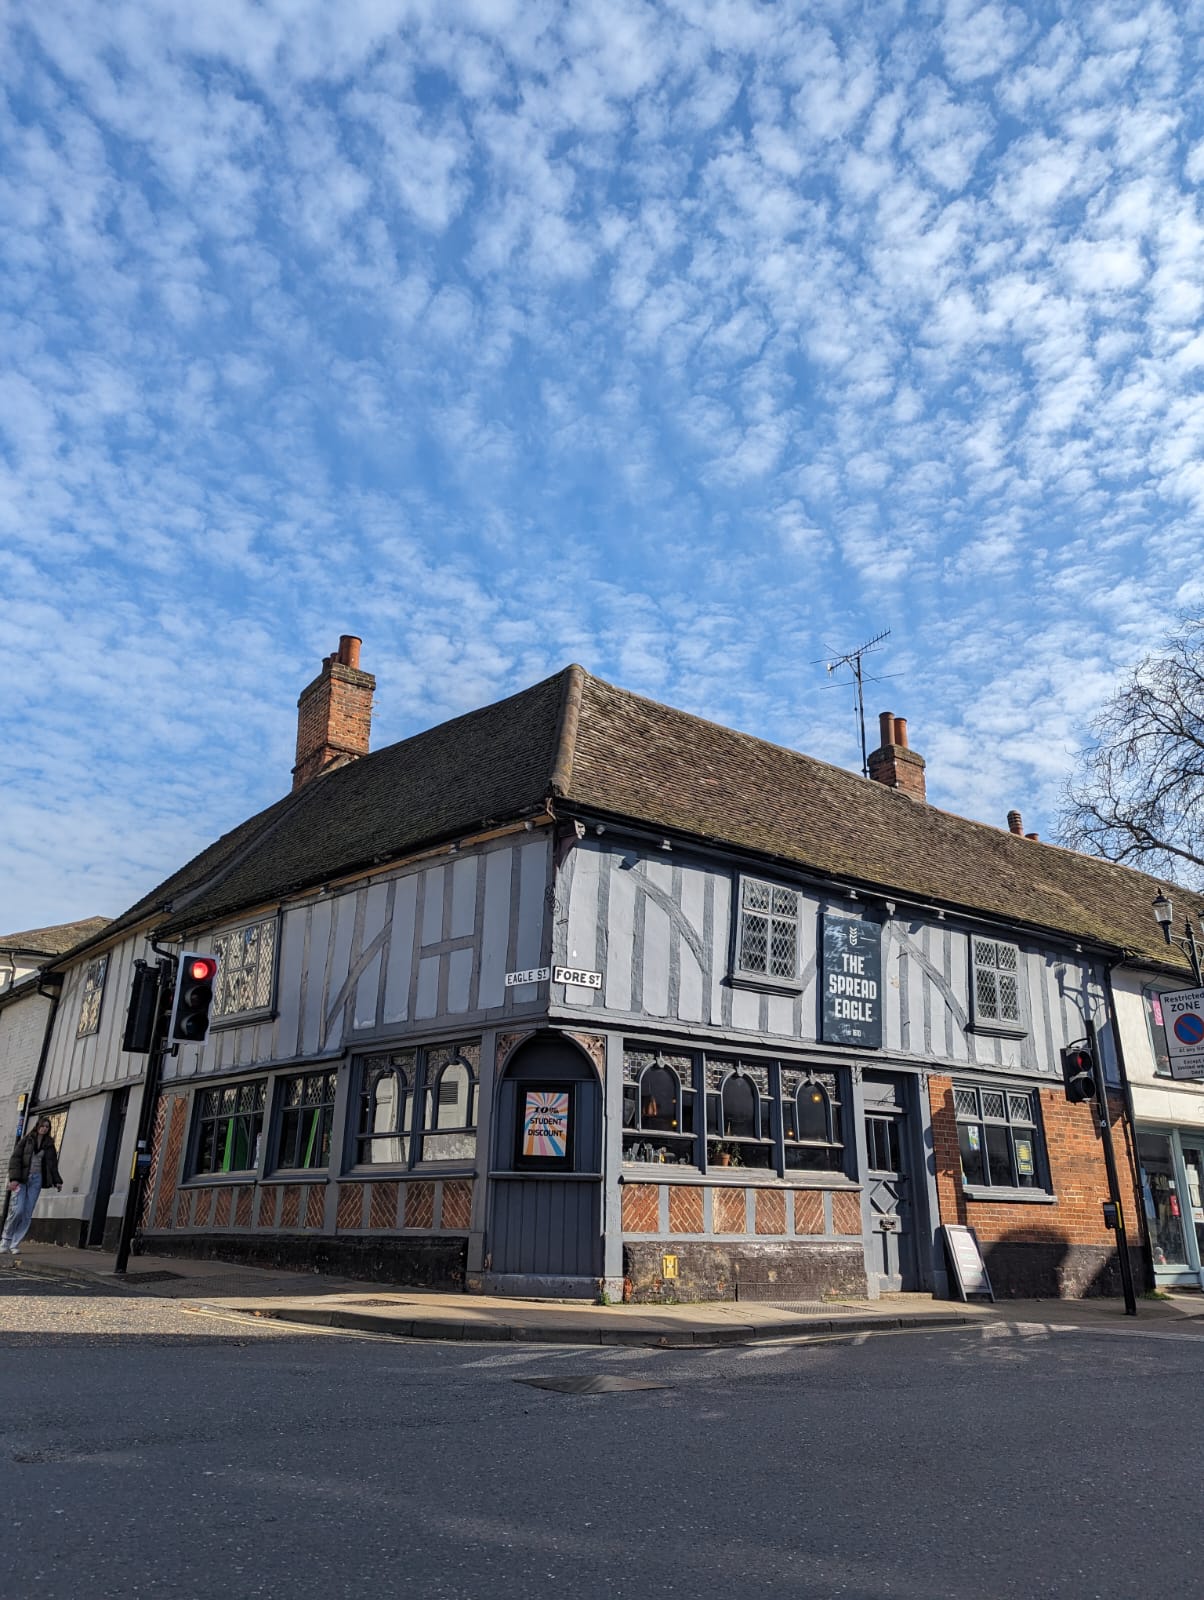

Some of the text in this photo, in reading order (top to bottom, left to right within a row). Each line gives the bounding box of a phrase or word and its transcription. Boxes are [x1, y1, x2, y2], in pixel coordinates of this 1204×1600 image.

[841, 953, 865, 975] THE
[507, 971, 534, 984] EAGLE
[556, 969, 587, 984] FORE
[829, 973, 877, 1000] SPREAD
[834, 998, 873, 1022] EAGLE
[1170, 1000, 1201, 1012] ZONE
[530, 1117, 563, 1125] STUDENT
[528, 1129, 563, 1137] DISCOUNT
